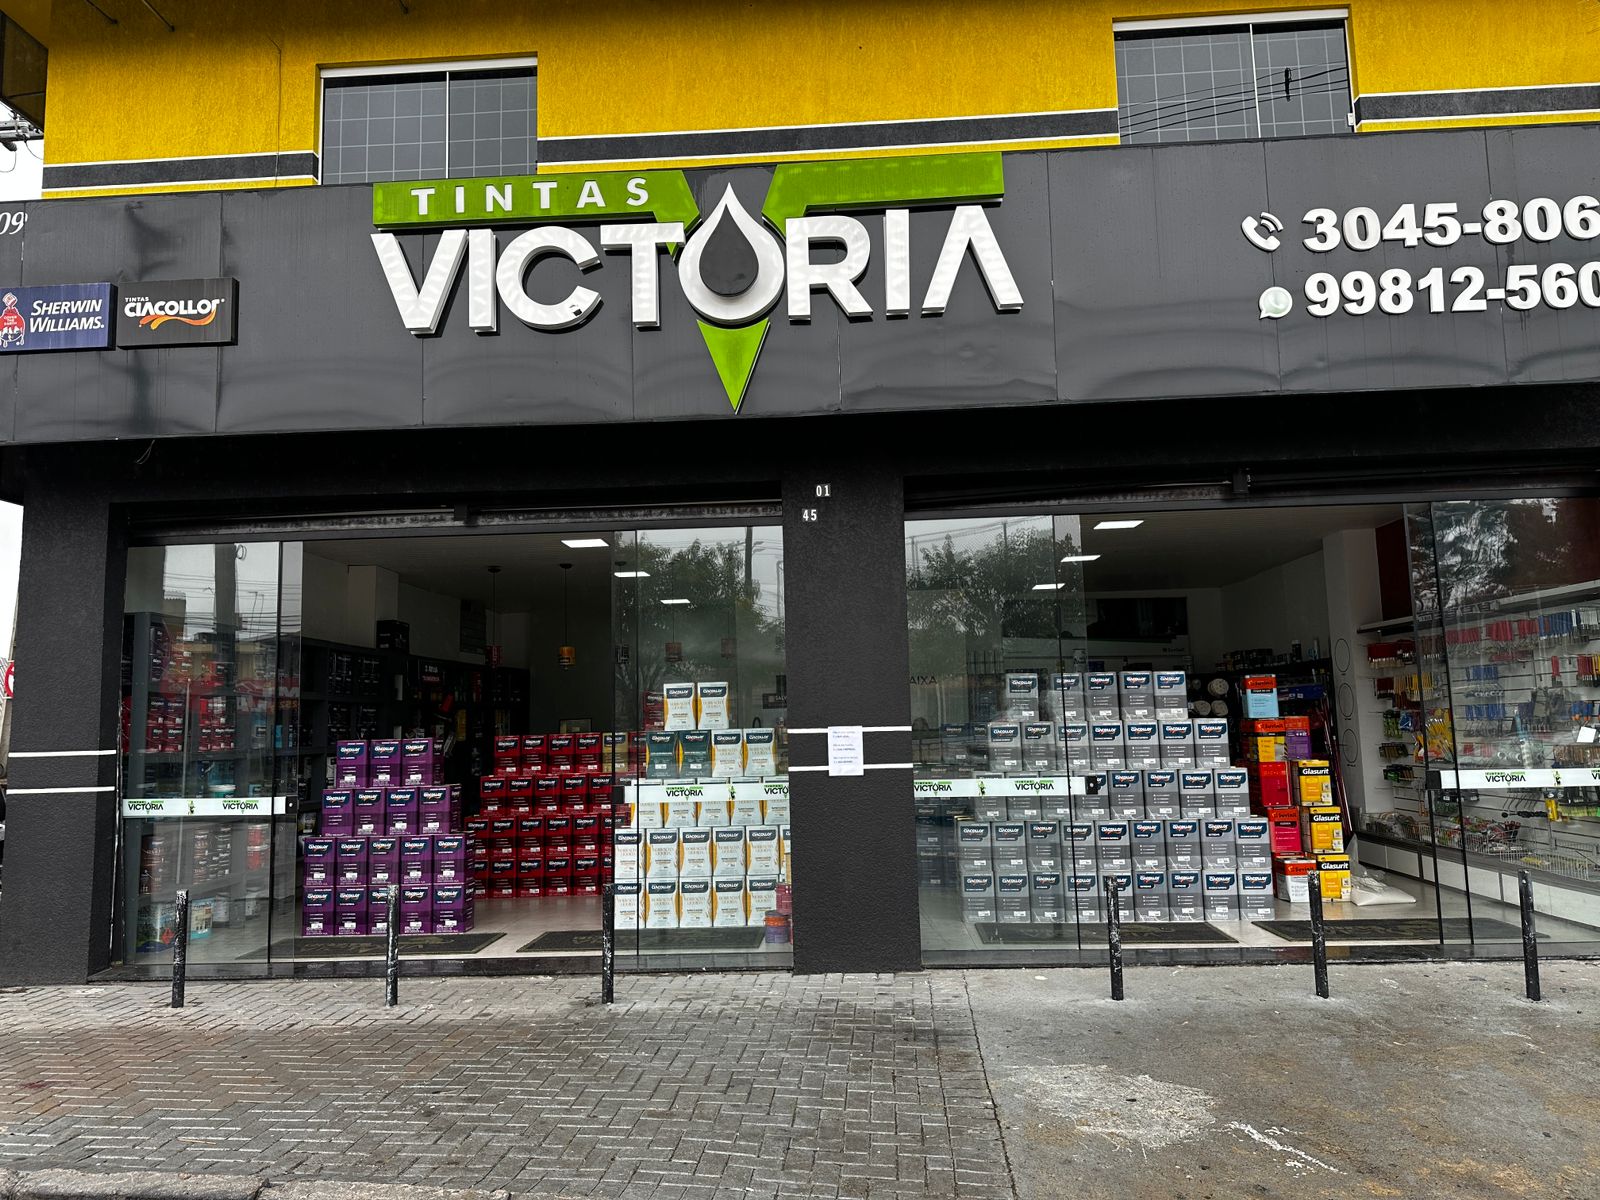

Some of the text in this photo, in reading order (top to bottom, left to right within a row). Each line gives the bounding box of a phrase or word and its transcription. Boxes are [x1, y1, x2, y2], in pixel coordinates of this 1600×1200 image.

[411, 176, 650, 216] TINTAS
[1303, 195, 1600, 253] 3045-806
[370, 182, 1024, 336] VICTORIA
[31, 299, 102, 316] SHERWIN
[815, 484, 830, 497] 01
[802, 509, 817, 522] 45
[1485, 774, 1526, 783] VICTORIA
[914, 783, 952, 792] VICTORIA
[1015, 782, 1054, 791] VICTORIA
[665, 788, 703, 797] VICTORIA
[128, 802, 164, 811] VICTORIA
[222, 801, 259, 810] VICTORIA
